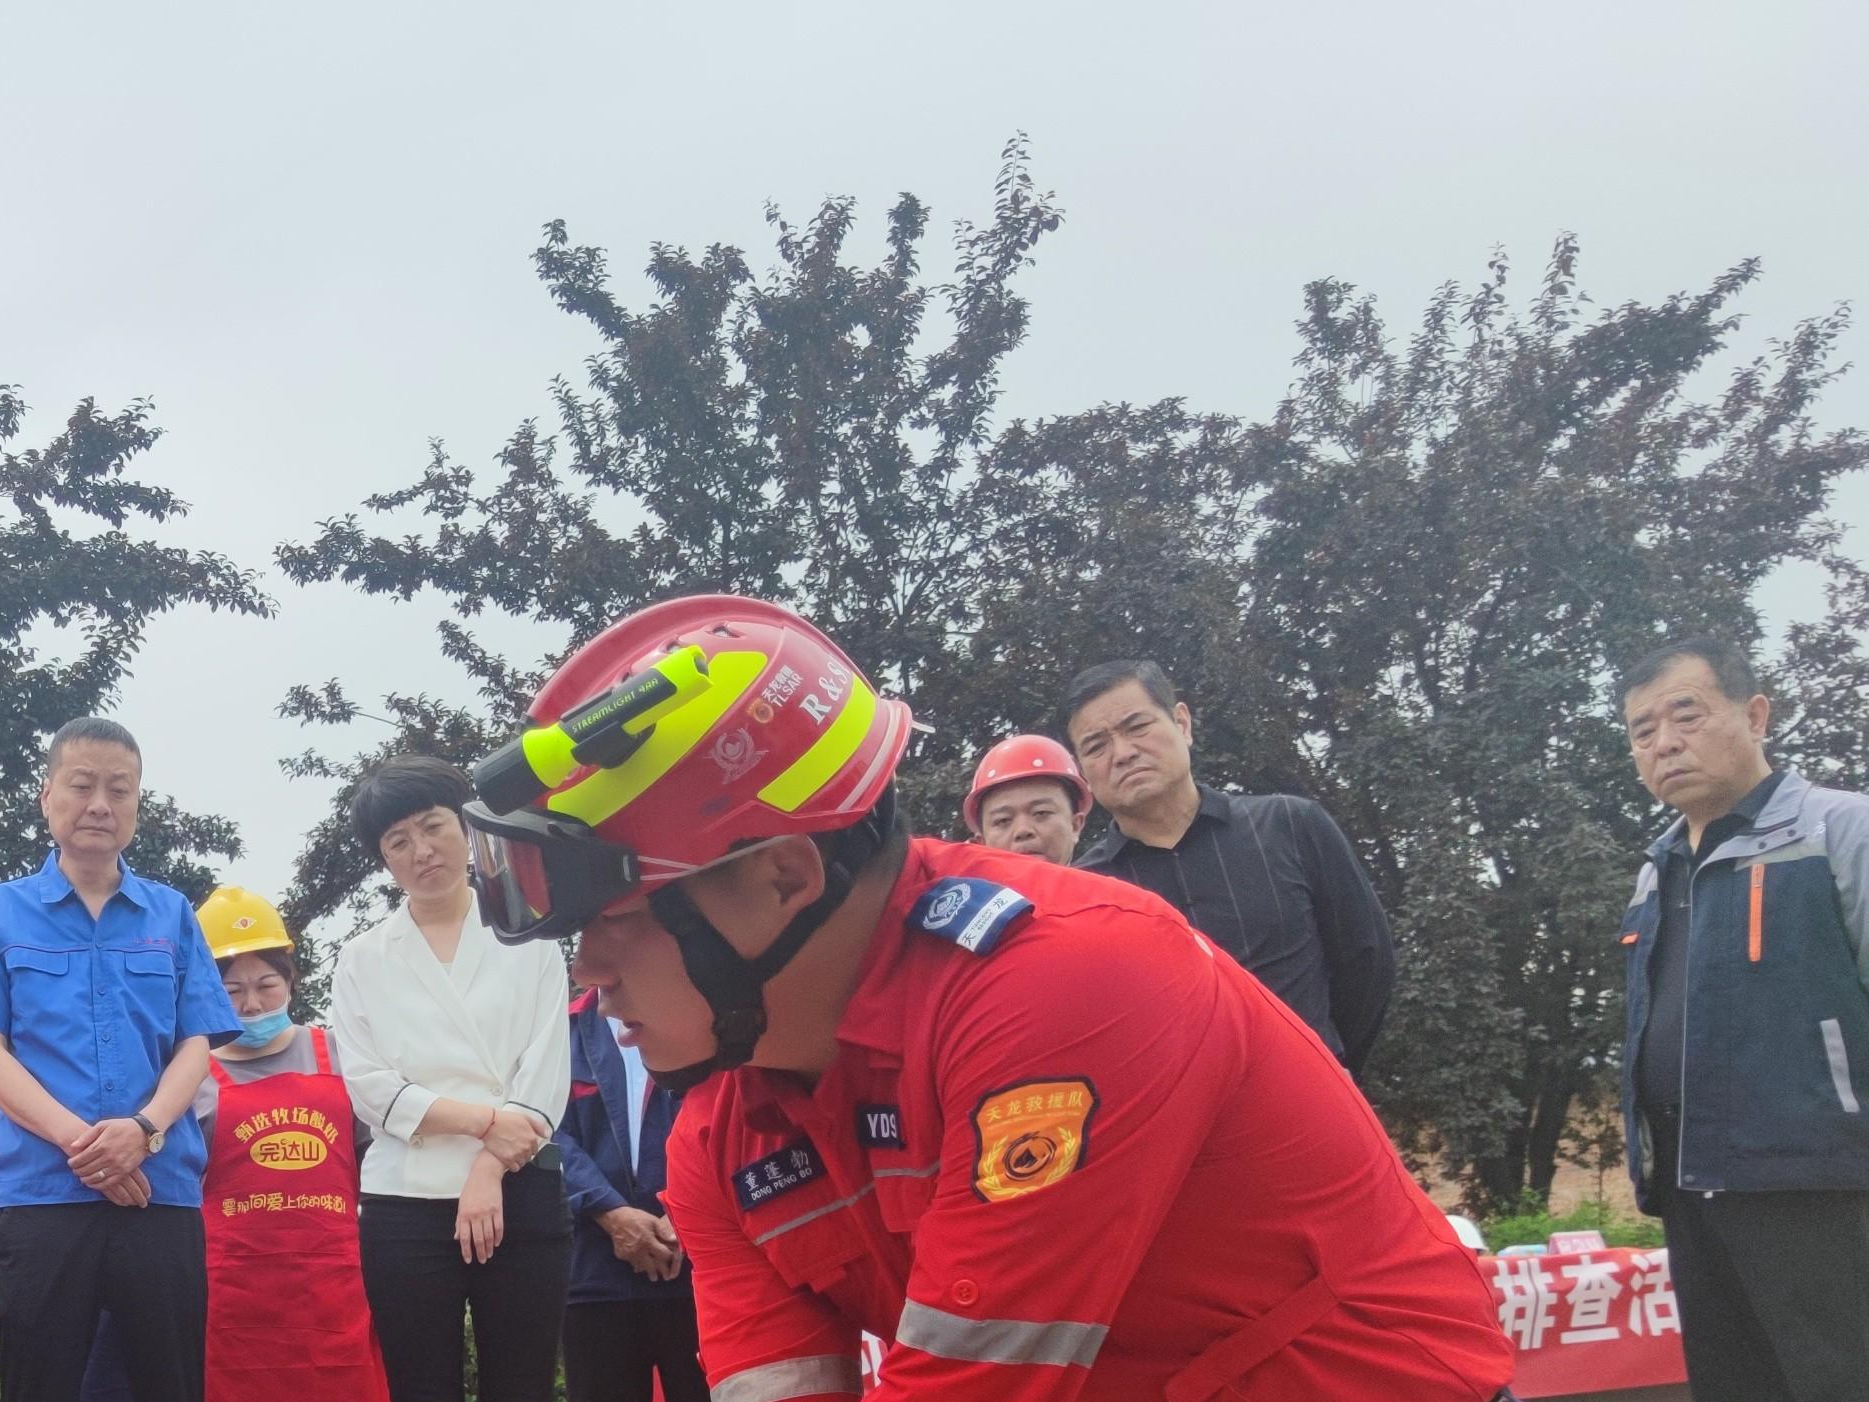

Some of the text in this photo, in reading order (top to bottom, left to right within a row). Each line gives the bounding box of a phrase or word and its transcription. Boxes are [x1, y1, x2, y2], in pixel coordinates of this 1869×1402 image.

[771, 673, 804, 708] TLSAR
[571, 690, 636, 734] STREAMLIGHT
[986, 1091, 1083, 1122] 天龙救援队
[233, 1107, 339, 1144] 甄选牧场酸奶
[259, 1140, 320, 1163] 完达山
[750, 1167, 812, 1201] DONG PENG BO
